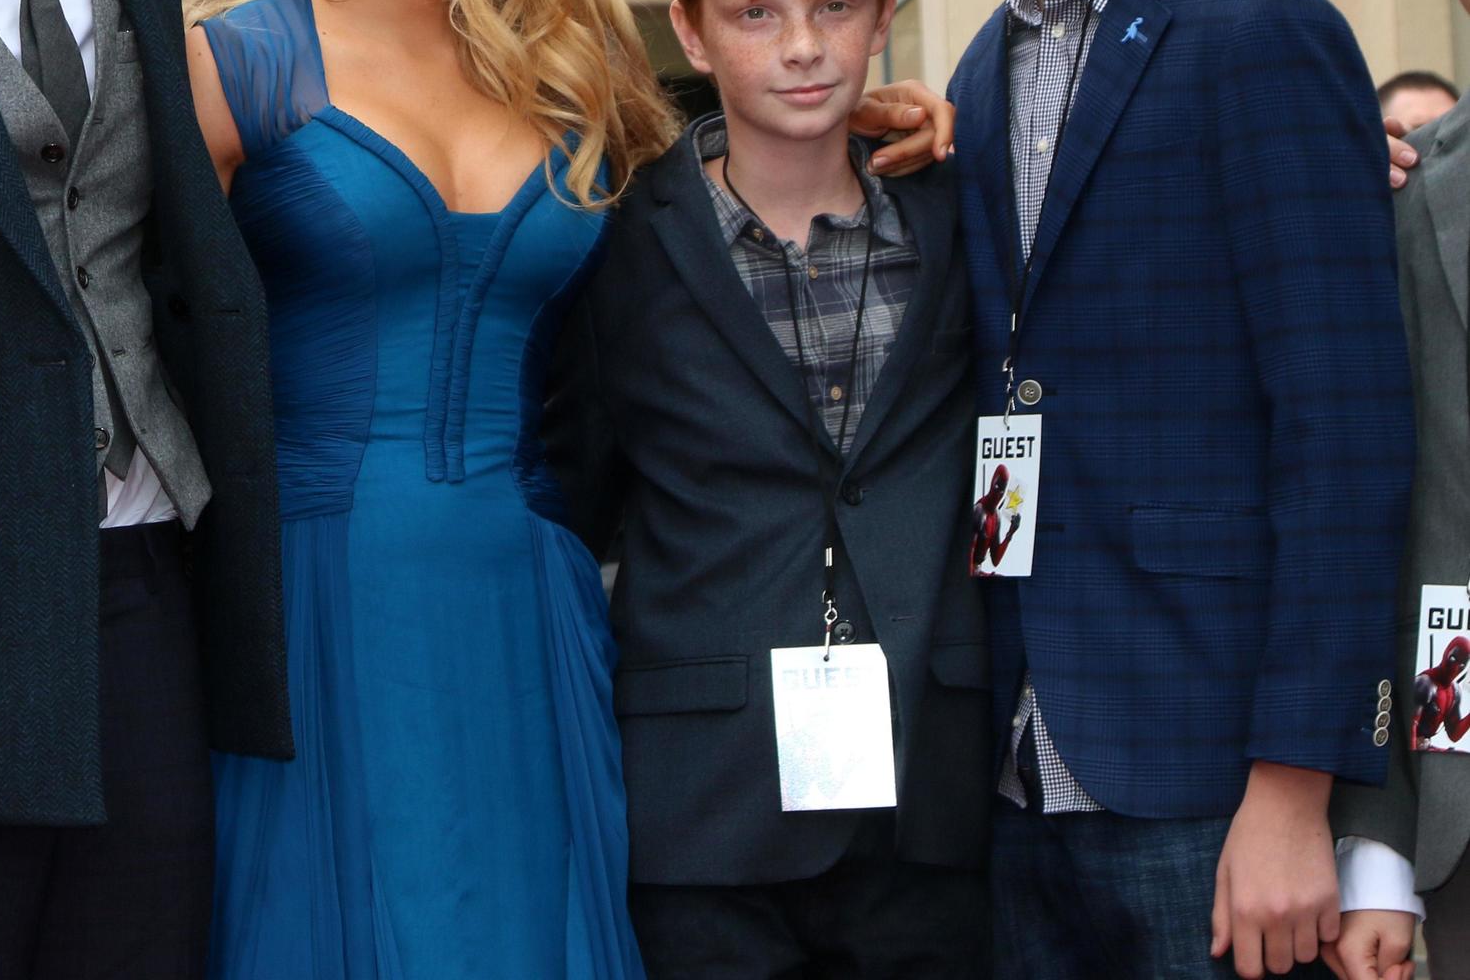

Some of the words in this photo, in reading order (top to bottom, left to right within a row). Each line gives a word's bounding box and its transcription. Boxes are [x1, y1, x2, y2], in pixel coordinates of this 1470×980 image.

[982, 436, 1035, 459] GUEST
[1428, 607, 1470, 631] GU
[782, 667, 873, 690] GUES
